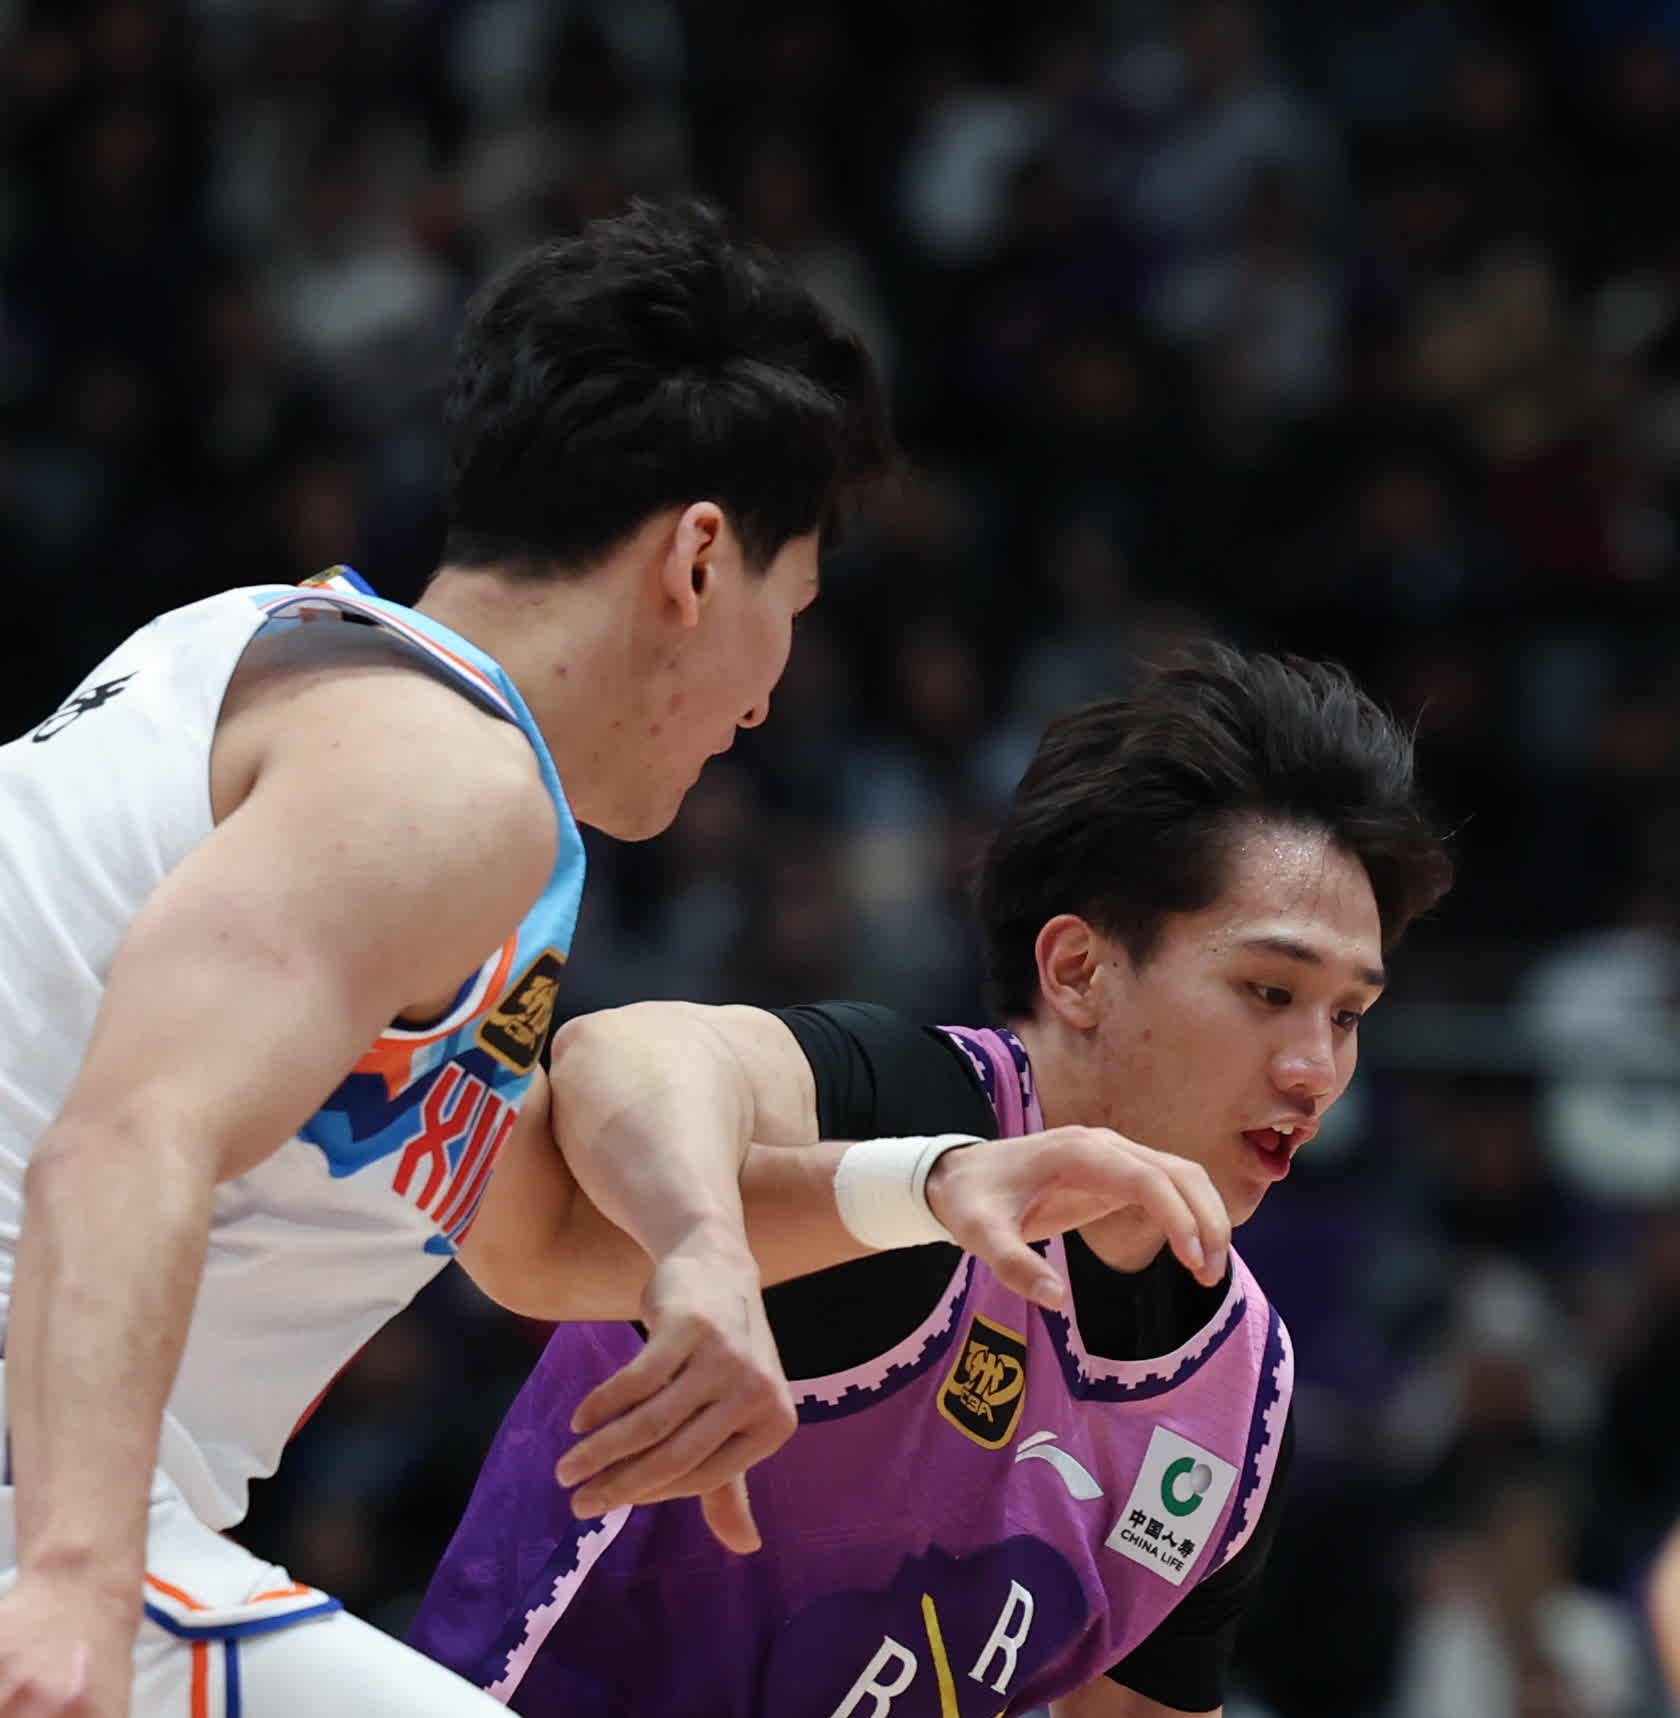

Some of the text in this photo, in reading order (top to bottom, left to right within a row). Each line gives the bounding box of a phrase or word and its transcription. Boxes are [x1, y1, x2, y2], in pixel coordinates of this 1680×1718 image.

[1120, 1529, 1185, 1572] CHINA LIFE
[1128, 1509, 1196, 1559] 中国人寿
[967, 1579, 1035, 1696] R
